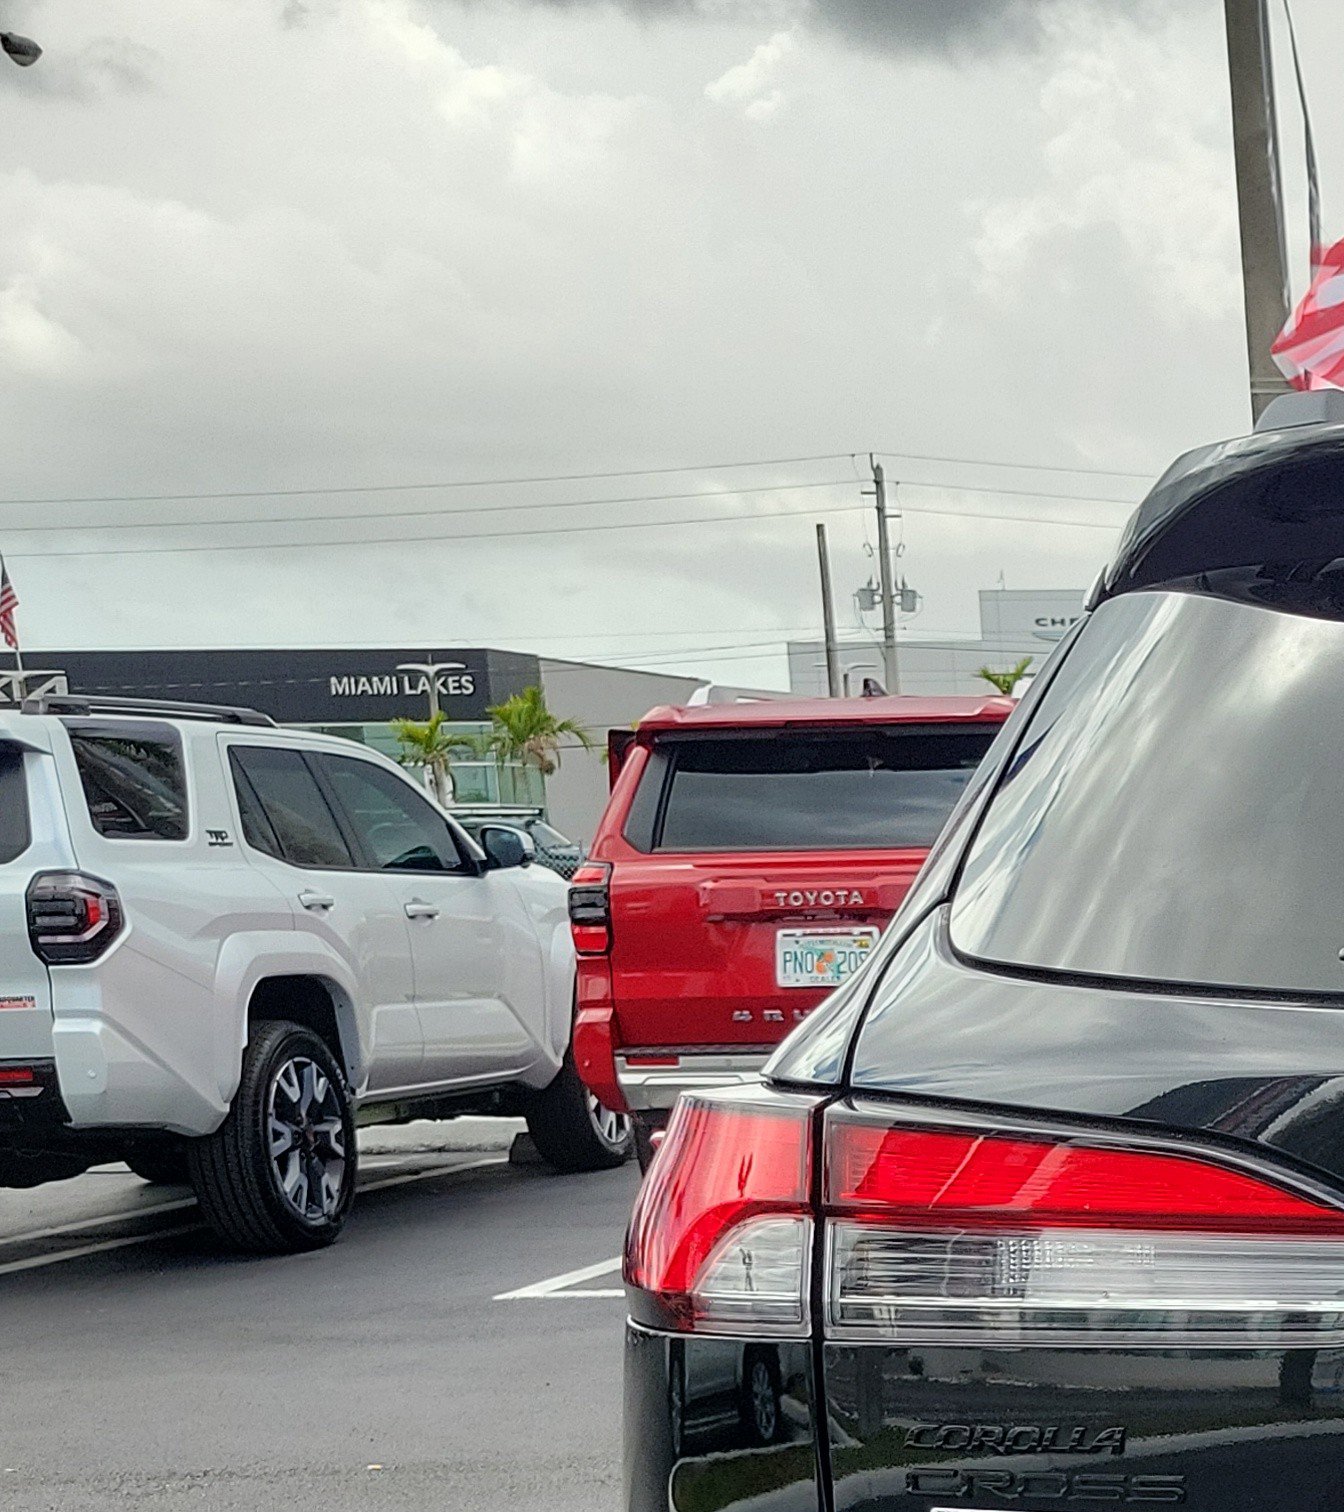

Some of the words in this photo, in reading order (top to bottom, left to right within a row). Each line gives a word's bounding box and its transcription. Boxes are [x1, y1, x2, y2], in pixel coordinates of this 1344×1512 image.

[329, 675, 398, 696] MIAMI
[403, 674, 475, 696] LAKES
[774, 890, 864, 906] TOYOTA
[904, 1423, 1127, 1456] COROLLA
[905, 1466, 1188, 1502] CROSS
